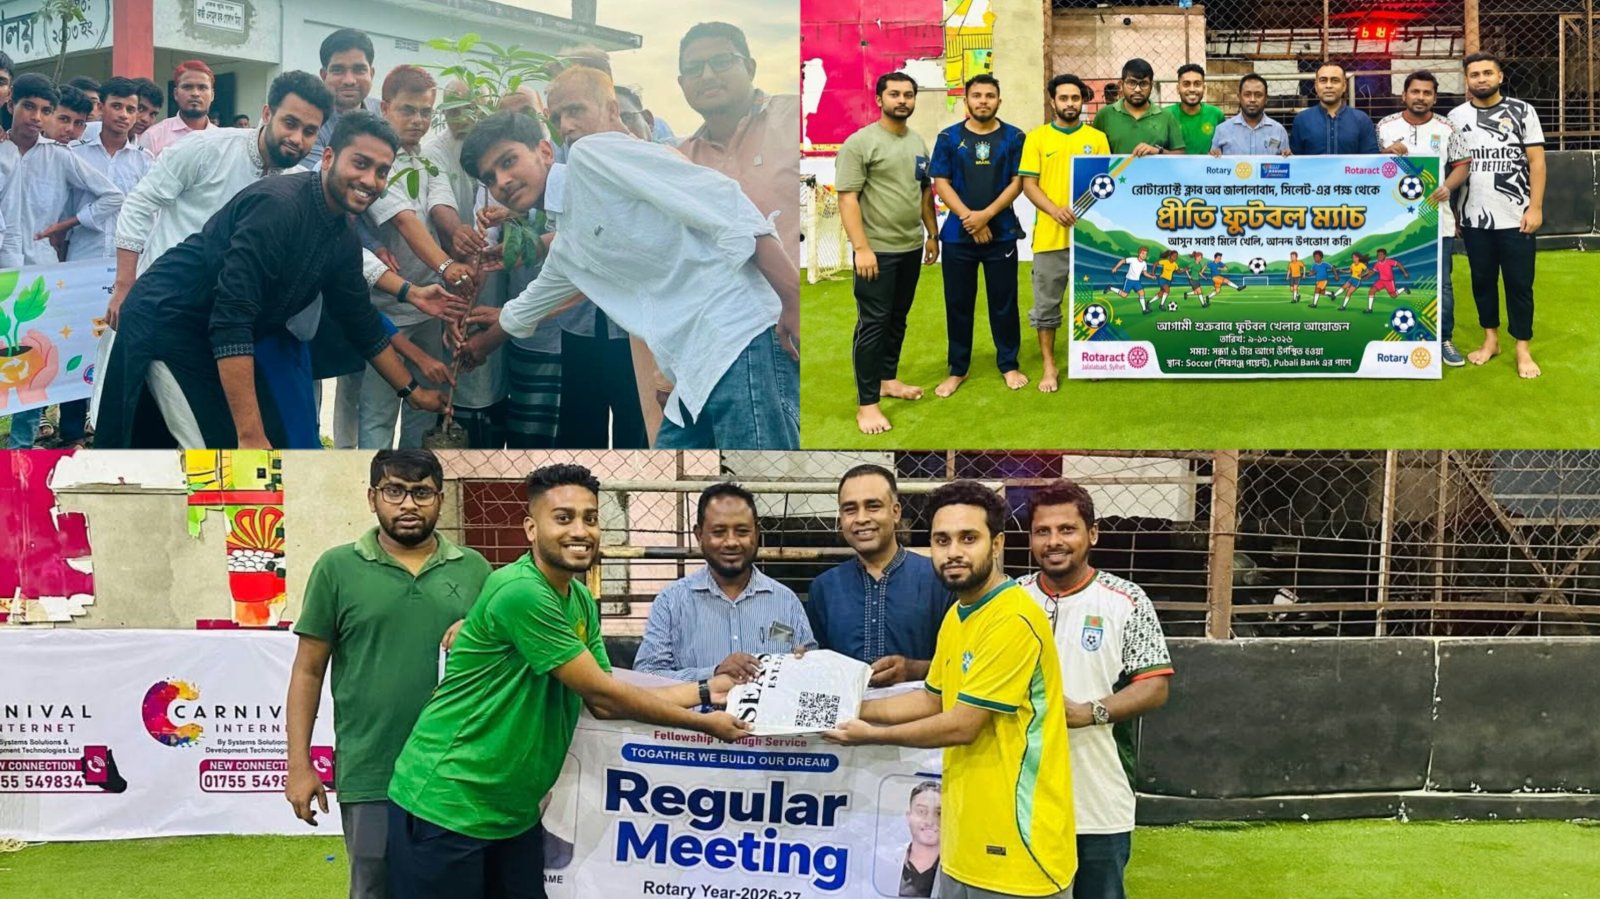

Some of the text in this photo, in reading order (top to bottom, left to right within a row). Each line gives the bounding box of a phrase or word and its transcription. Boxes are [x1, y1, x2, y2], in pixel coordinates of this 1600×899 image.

[1469, 145, 1520, 159] mirates
[1206, 166, 1231, 175] Rotary
[1345, 166, 1380, 175] Rotaract
[1471, 160, 1512, 172] LY BETTER
[1184, 184, 1203, 196] ক্লাব
[1204, 184, 1221, 195] অব
[1333, 184, 1352, 195] পক্ষ
[1355, 184, 1381, 195] থেকে
[1156, 197, 1367, 236] প্রীতি ফুটবল ম্যাচ
[1168, 237, 1193, 248] আসুন
[1194, 236, 1216, 246] সবাই
[1217, 235, 1238, 246] মিলে
[1266, 237, 1293, 246] আনন্দ
[1156, 318, 1192, 331] আগামী
[1235, 320, 1267, 334] ফুটবল
[1269, 322, 1301, 331] খেলার
[1081, 352, 1125, 362] Rotaract
[1239, 346, 1253, 356] টার
[1254, 347, 1275, 356] আগে
[1185, 359, 1213, 367] Soccer
[1273, 358, 1298, 367] Pubali
[1300, 358, 1320, 367] Bank
[1321, 359, 1333, 367] এর
[1377, 353, 1409, 364] Rotary
[174, 705, 282, 718] CARNIV
[215, 724, 287, 733] INTERN
[217, 739, 226, 747] By
[228, 739, 256, 747] Systems
[654, 731, 713, 744] Fellowship
[766, 737, 808, 747] Service
[22, 747, 66, 755] Technologies
[250, 747, 288, 755] Technolog
[631, 747, 830, 767] TOGATHER WE BUILD OUR DREAM
[8, 761, 76, 770] CONNECTION
[210, 761, 288, 770] NEW CONNECTI
[25, 775, 83, 788] 549834
[204, 775, 287, 788] 01755 5498
[605, 768, 848, 831] Regular
[616, 821, 849, 890] Meeting
[543, 874, 563, 884] AME
[643, 881, 696, 899] Rotary
